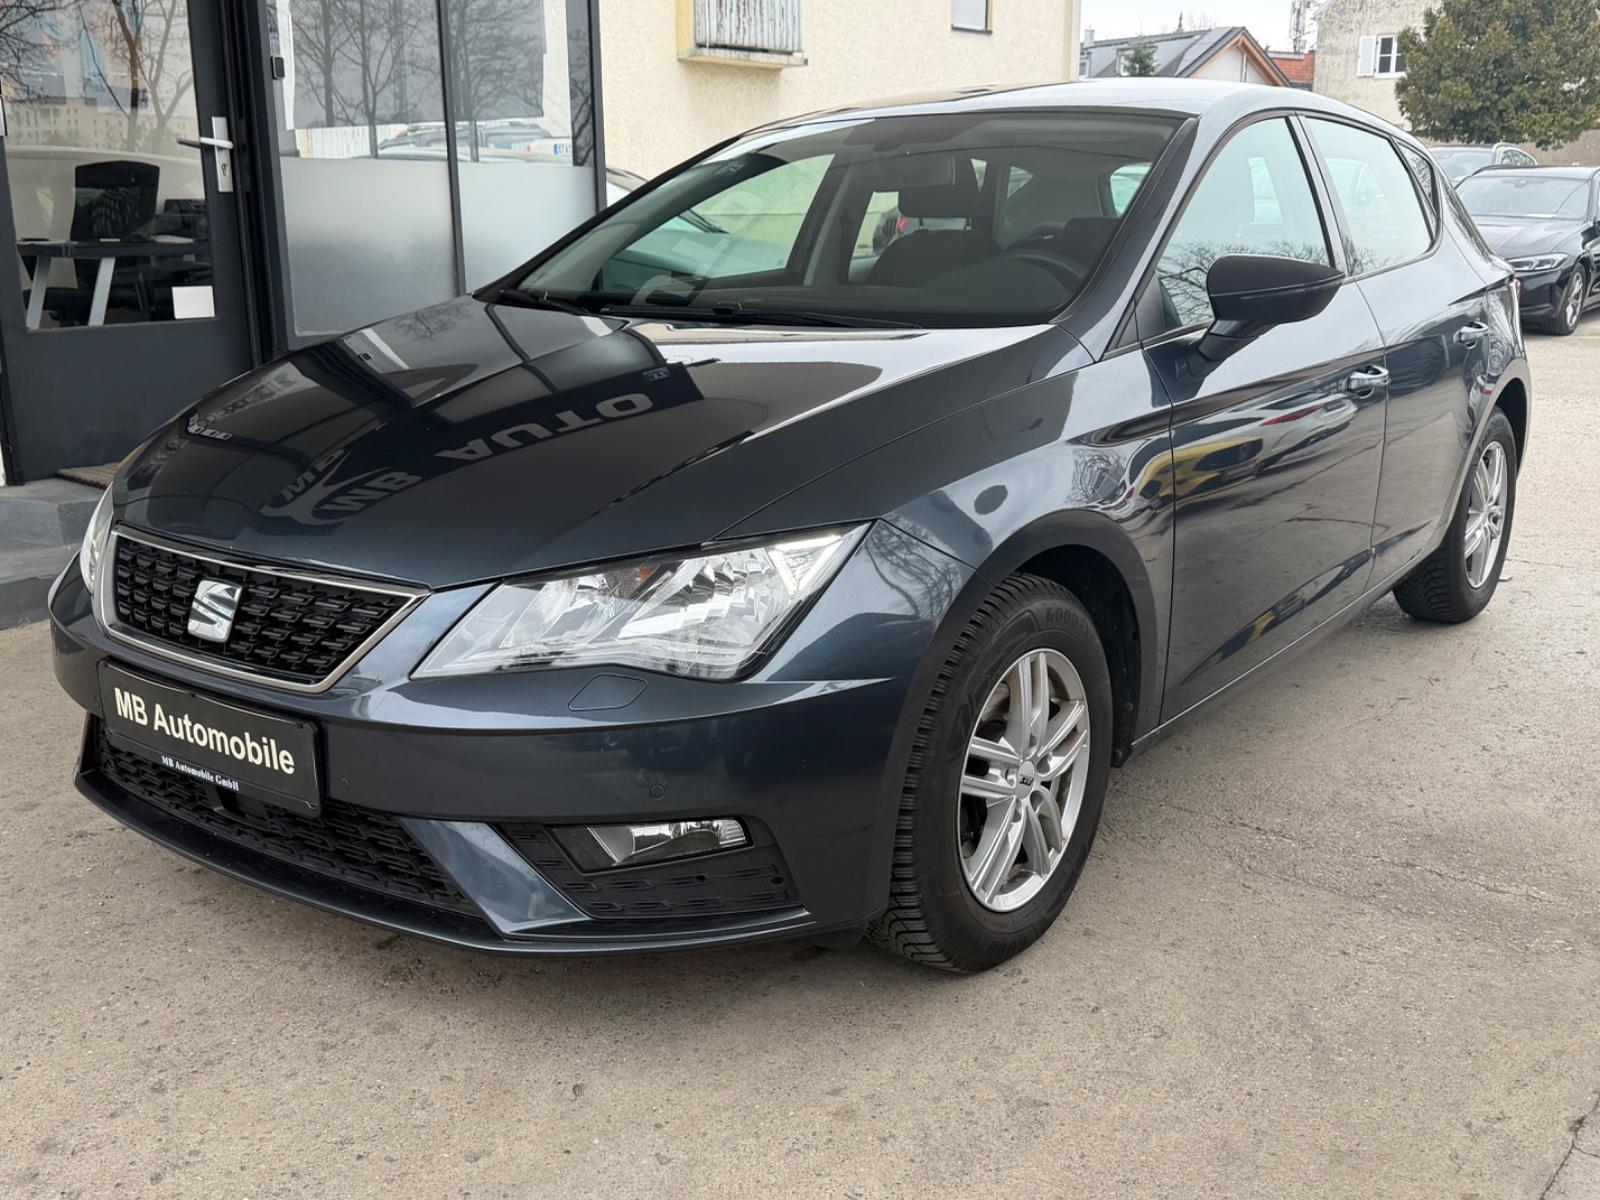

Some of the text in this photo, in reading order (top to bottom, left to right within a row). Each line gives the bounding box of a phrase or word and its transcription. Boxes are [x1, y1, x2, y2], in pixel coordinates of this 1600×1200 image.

[114, 687, 295, 775] MB Automobile
[161, 755, 239, 791] MB Automobile GmbH
